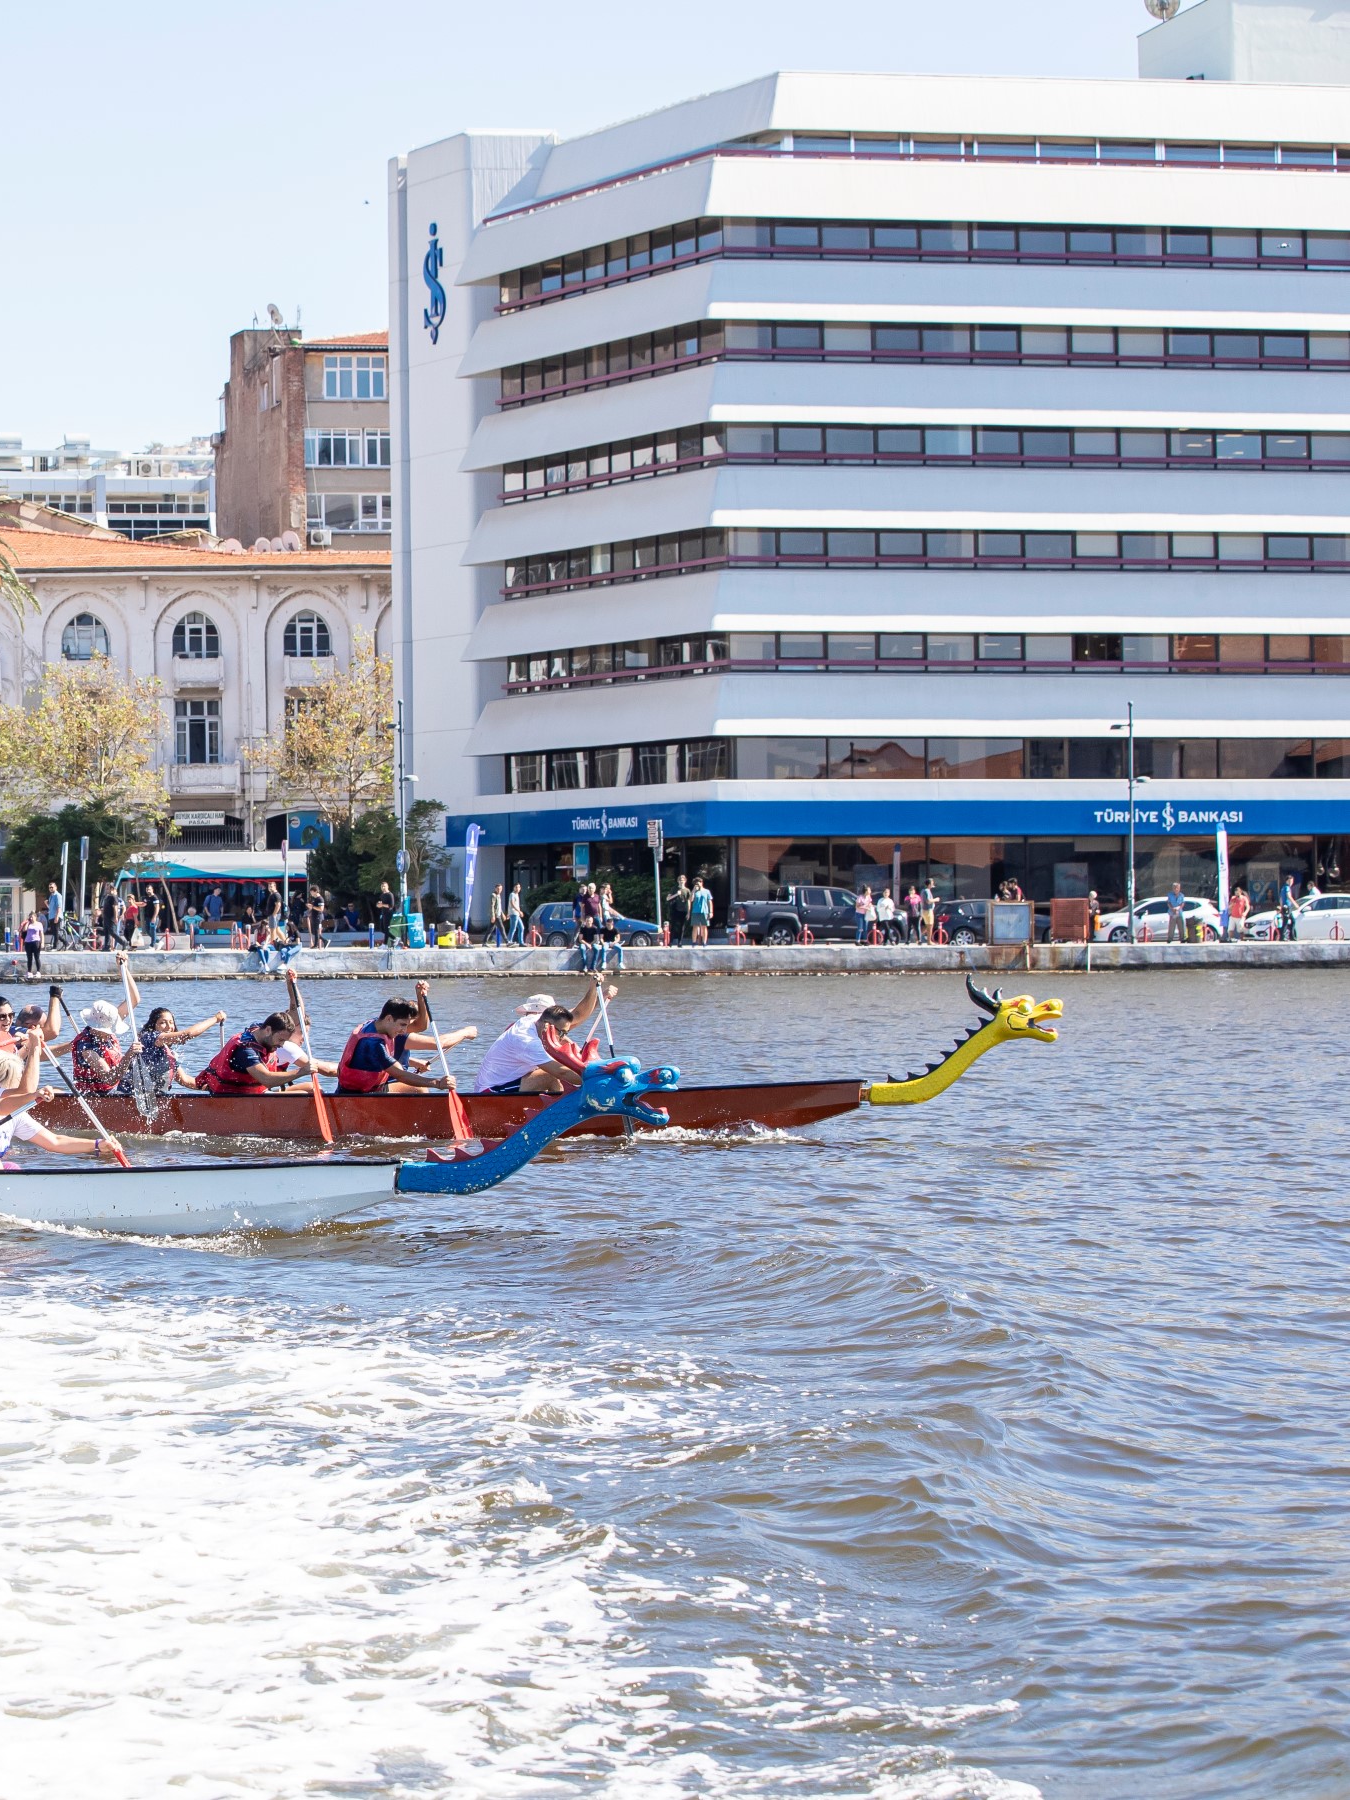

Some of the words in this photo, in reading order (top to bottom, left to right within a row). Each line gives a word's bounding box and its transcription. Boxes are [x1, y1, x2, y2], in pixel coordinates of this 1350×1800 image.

[1094, 808, 1159, 823] TÜRKİYE
[1178, 811, 1243, 823] BANKASI
[572, 816, 600, 830] TÜRKİYE
[608, 816, 638, 829] BANKASI
